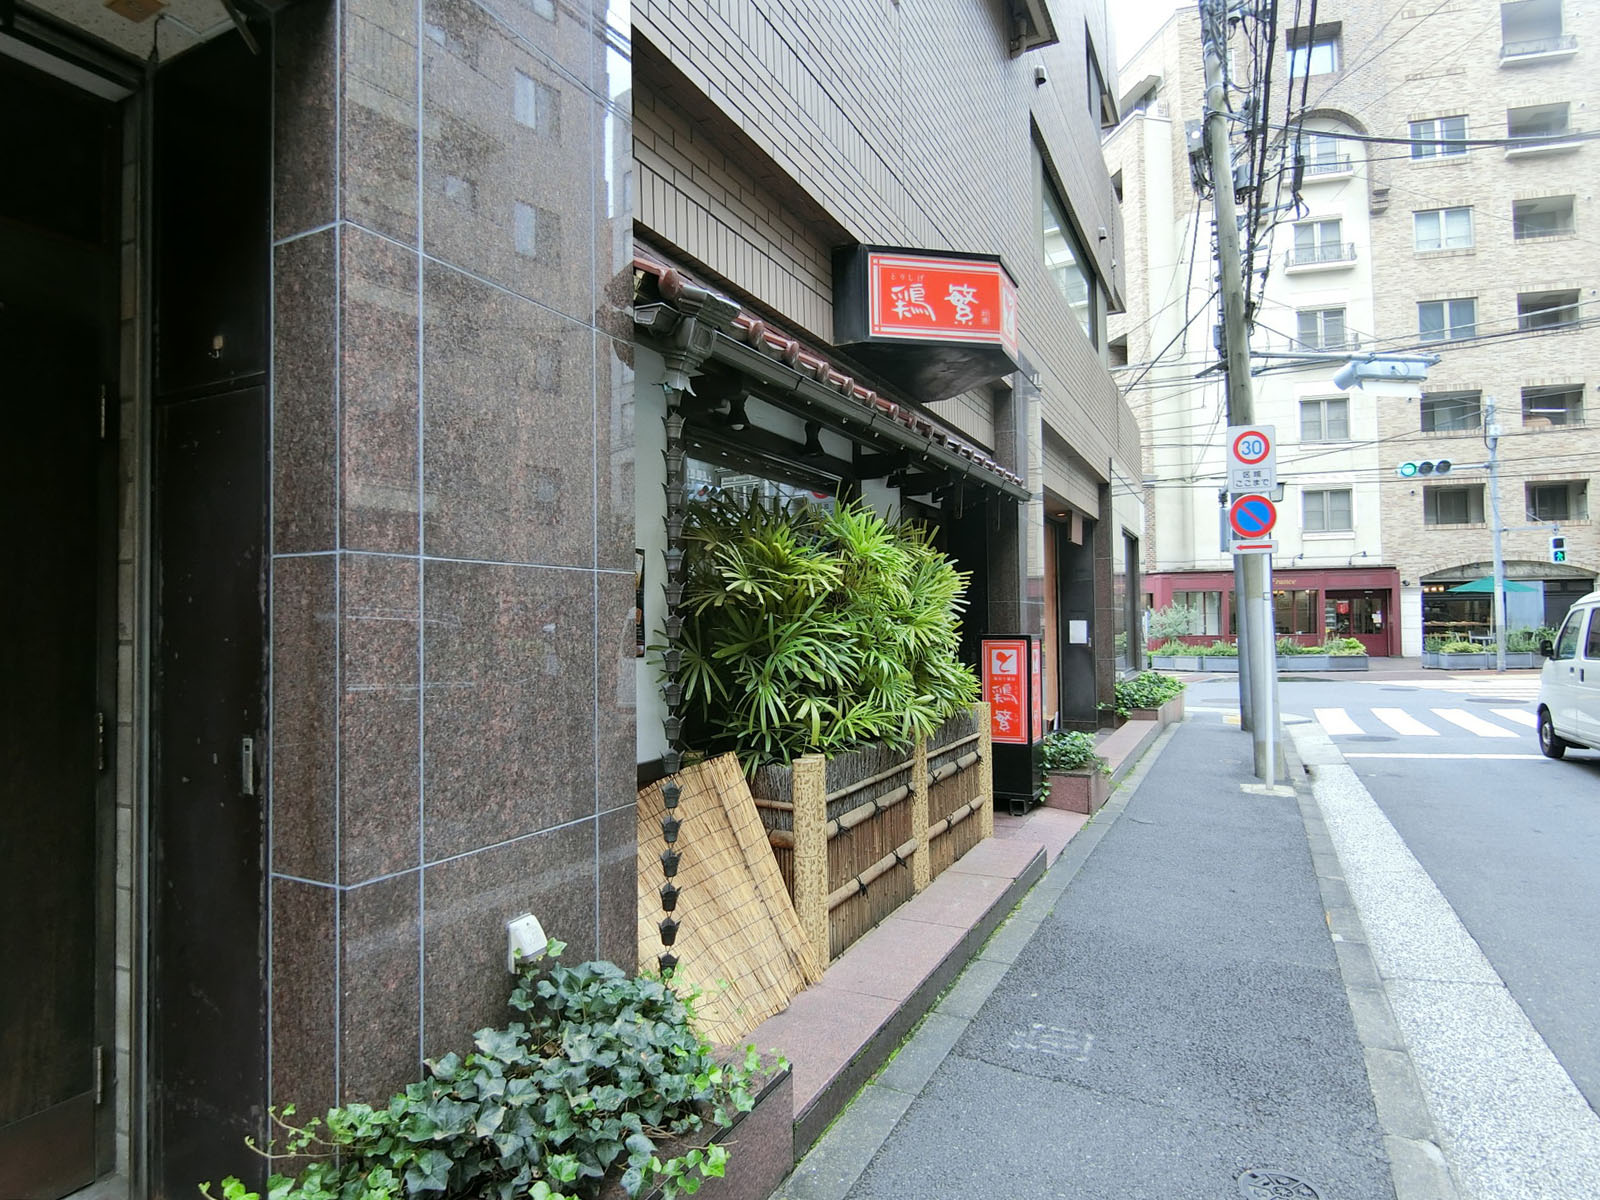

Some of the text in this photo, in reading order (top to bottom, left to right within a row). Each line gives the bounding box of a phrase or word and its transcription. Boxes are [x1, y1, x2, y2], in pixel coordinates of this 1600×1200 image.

[1241, 440, 1262, 455] 30
[1235, 479, 1270, 488] ここまで
